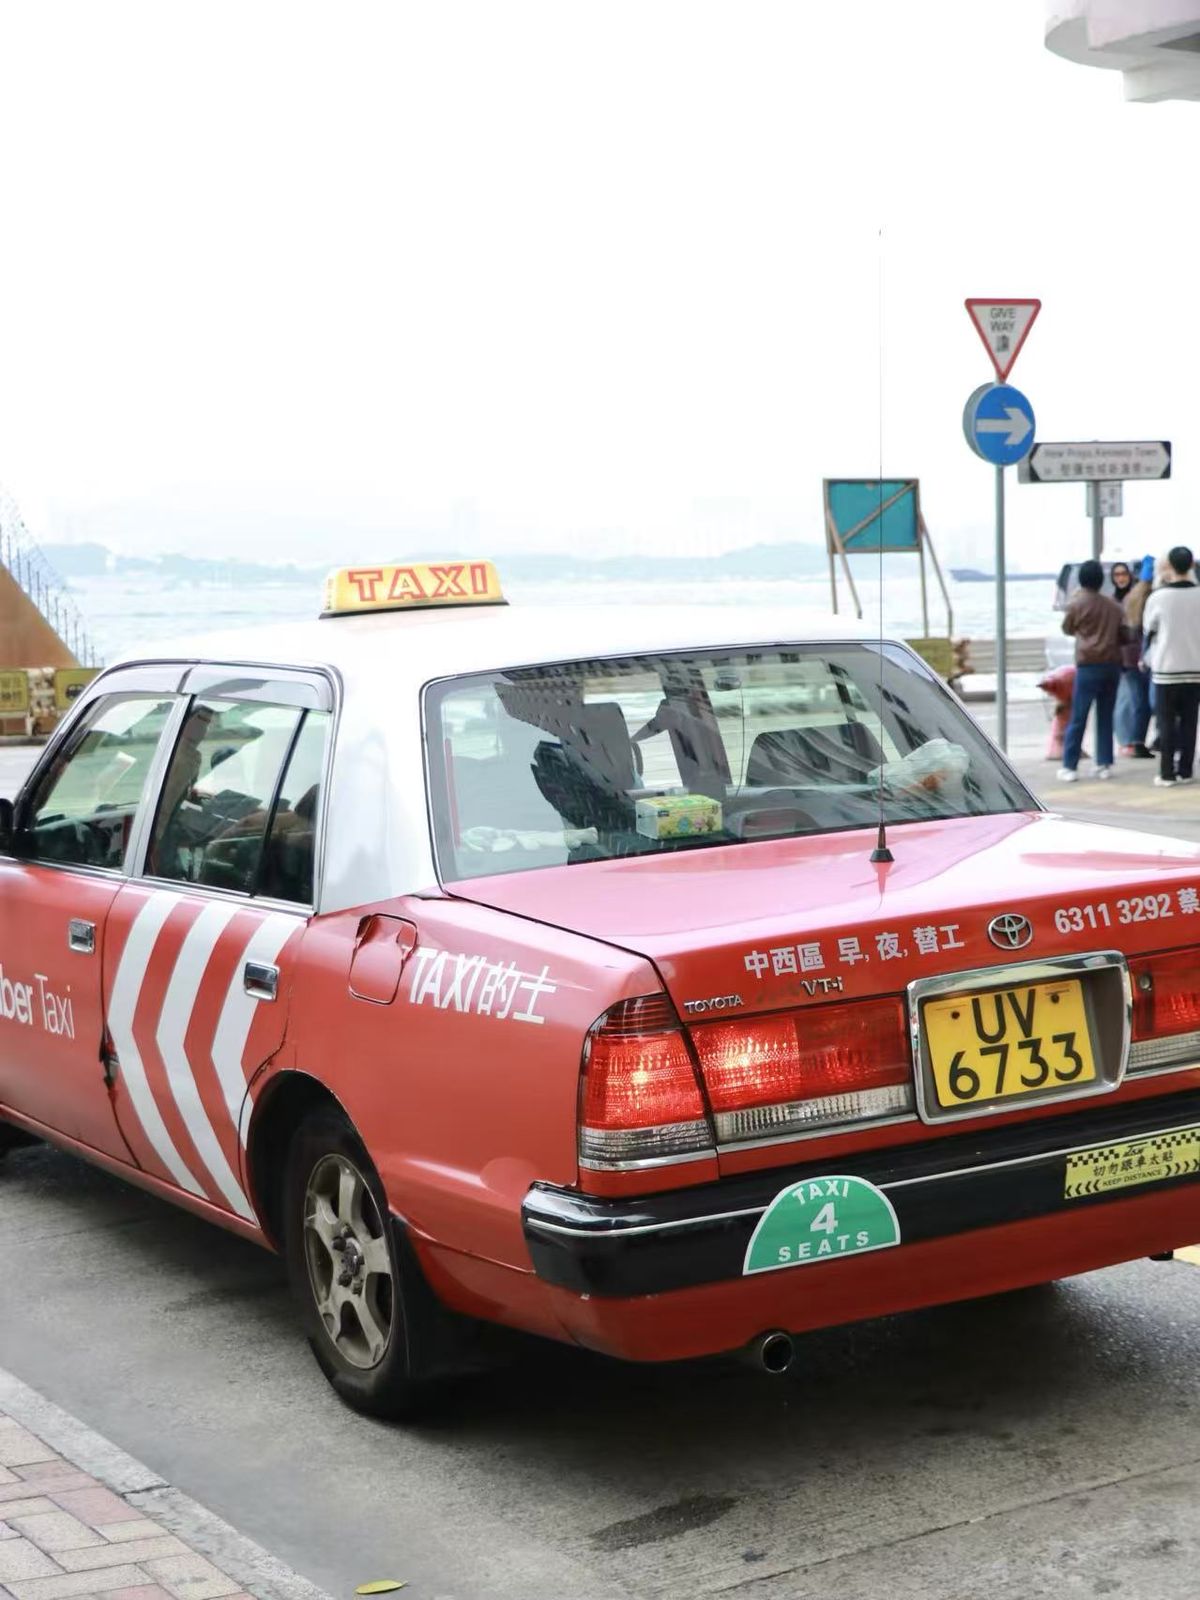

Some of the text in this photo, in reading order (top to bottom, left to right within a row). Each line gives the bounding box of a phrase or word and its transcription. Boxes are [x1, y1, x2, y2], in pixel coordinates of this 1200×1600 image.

[990, 307, 1016, 319] GIVE
[990, 321, 1015, 332] WAY
[348, 564, 488, 601] TAXI
[1055, 903, 1111, 934] 6311
[1116, 894, 1173, 924] 3292
[744, 942, 826, 979] 中西區
[34, 973, 75, 1039] Taxi
[684, 995, 744, 1014] TOYOTA
[971, 988, 1036, 1044] UV
[948, 1031, 1083, 1100] 6733
[792, 1179, 850, 1206] TAXI
[1102, 1168, 1162, 1187] KEEP DISTANCE
[809, 1202, 838, 1235] 4
[778, 1231, 869, 1262] SEATS
